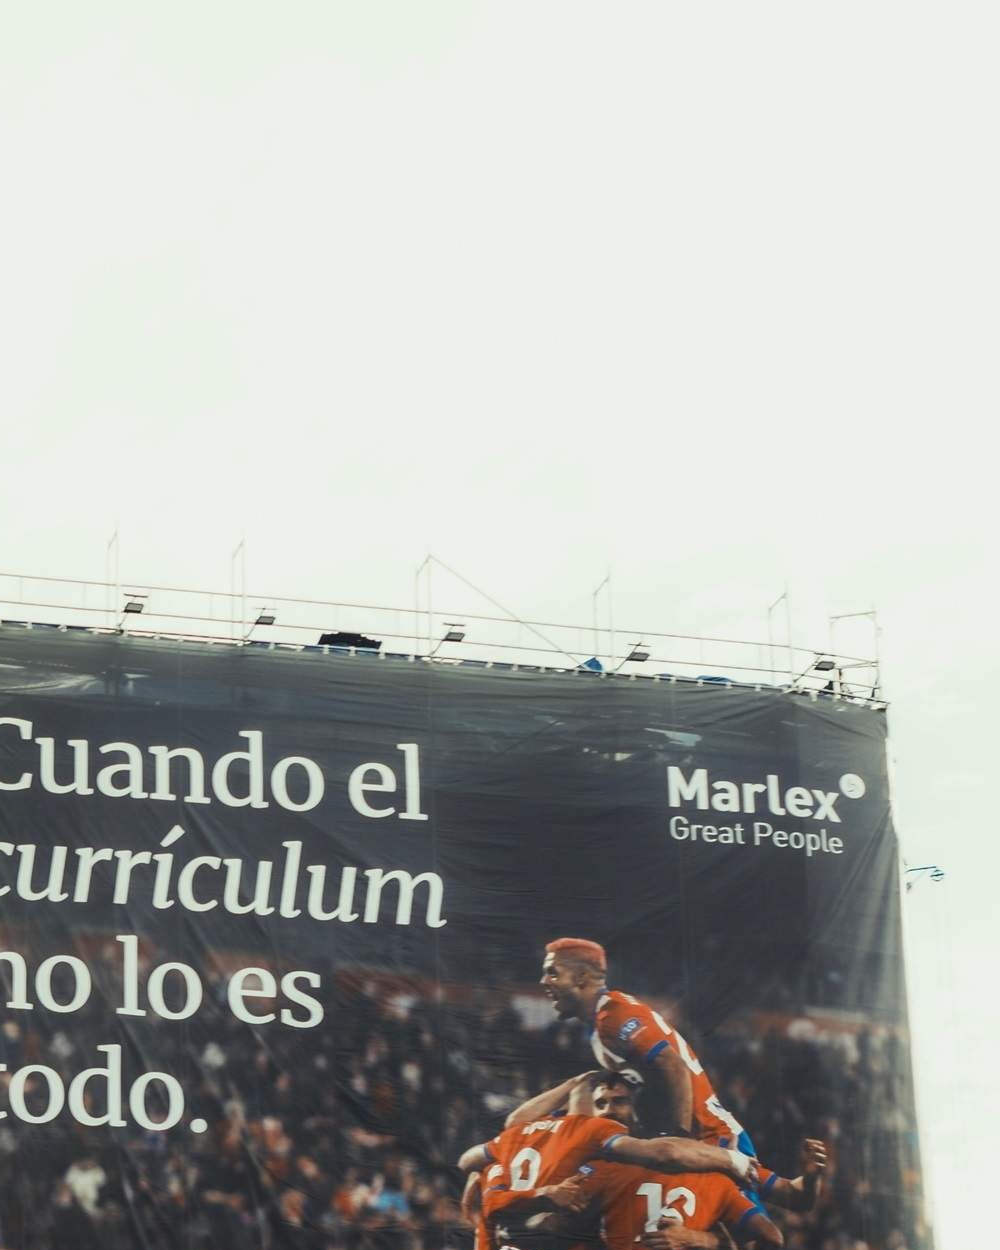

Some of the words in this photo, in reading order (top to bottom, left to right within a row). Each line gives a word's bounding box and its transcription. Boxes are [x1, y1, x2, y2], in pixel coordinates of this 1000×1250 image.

[348, 743, 428, 820] el
[667, 766, 842, 823] Marlex
[669, 816, 745, 845] Great
[754, 822, 844, 856] People
[116, 935, 202, 1020] lo
[227, 967, 324, 1028] es
